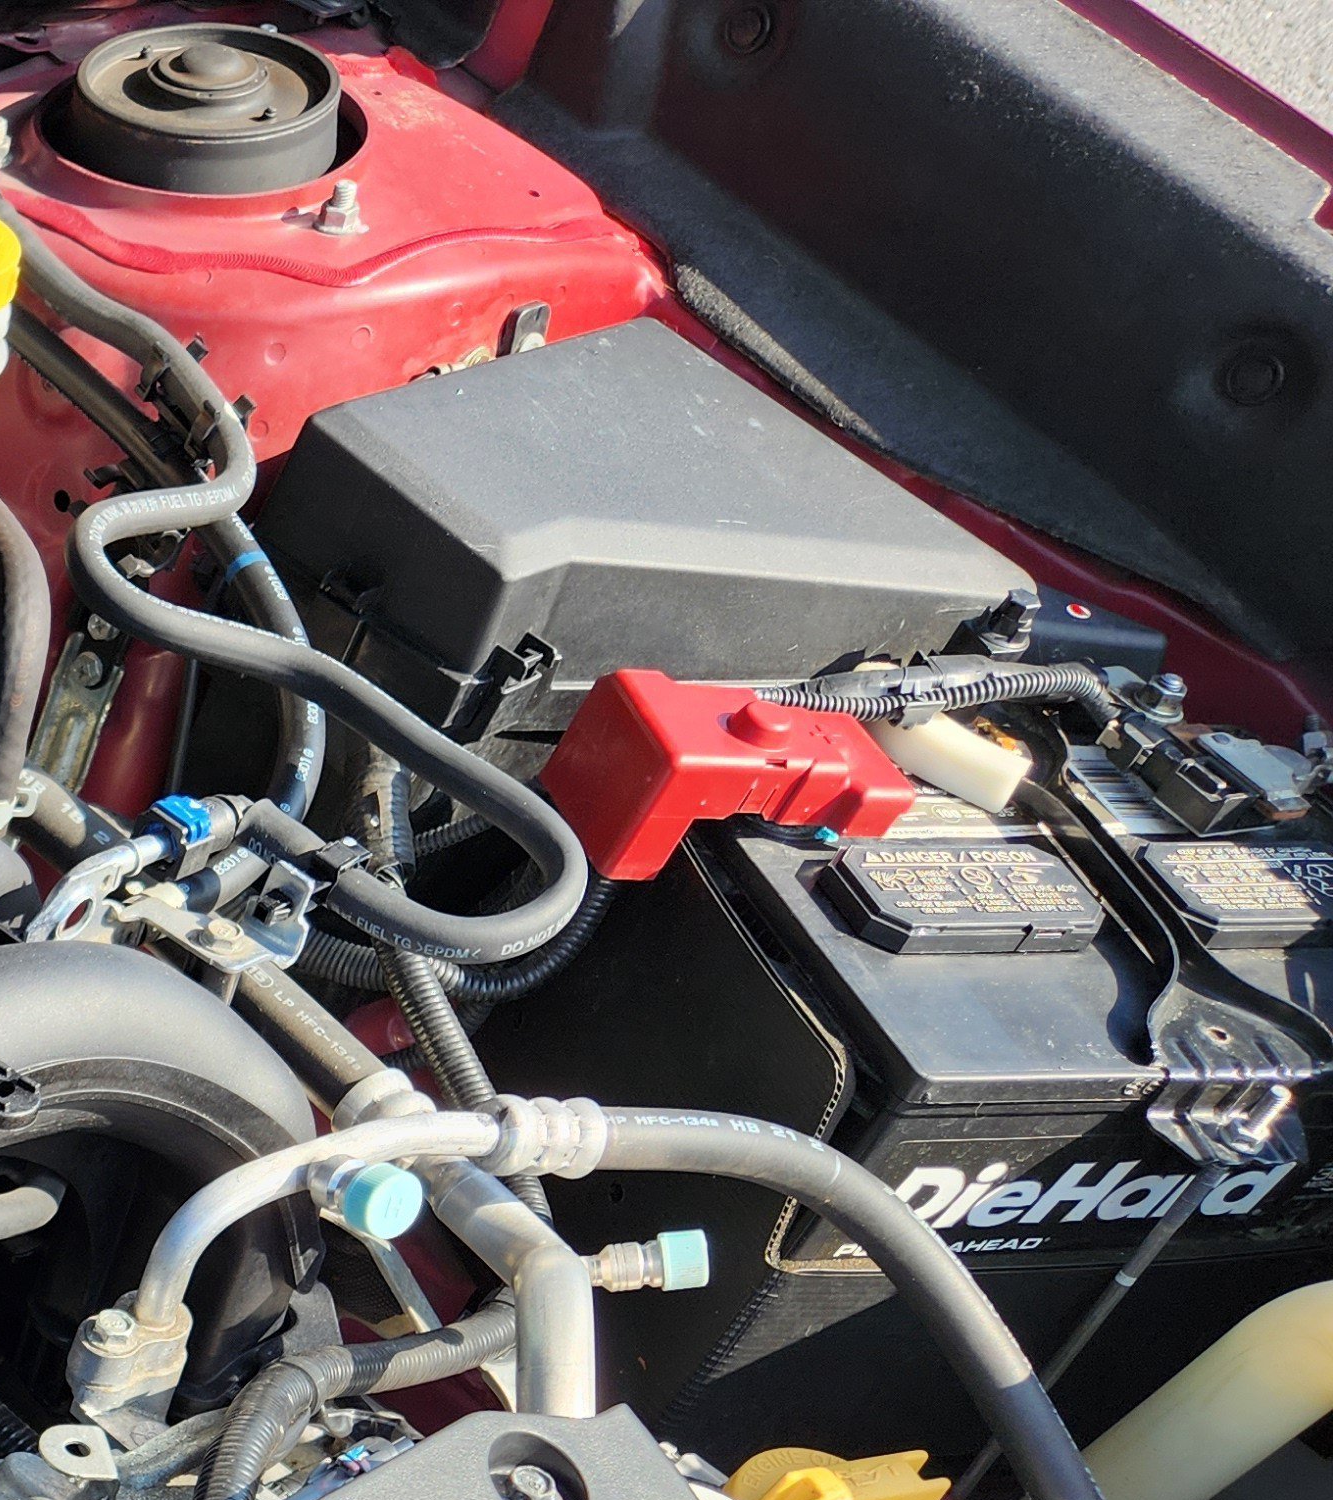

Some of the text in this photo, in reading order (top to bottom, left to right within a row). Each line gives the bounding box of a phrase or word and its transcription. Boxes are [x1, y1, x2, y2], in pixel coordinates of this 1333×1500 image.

[159, 492, 188, 510] FUEL
[188, 490, 202, 507] TG
[18, 768, 47, 795] HB
[92, 830, 111, 845] 2
[212, 853, 239, 876] 8301
[882, 851, 956, 864] DANGER
[971, 851, 1038, 864] POISON
[356, 916, 387, 941] FUEL
[393, 932, 412, 950] TG
[501, 940, 525, 956] DO
[526, 924, 555, 948] NOT
[273, 990, 295, 1008] LP
[729, 1118, 760, 1135] HB
[770, 1124, 798, 1142] 21
[742, 1449, 806, 1488] ENGINE
